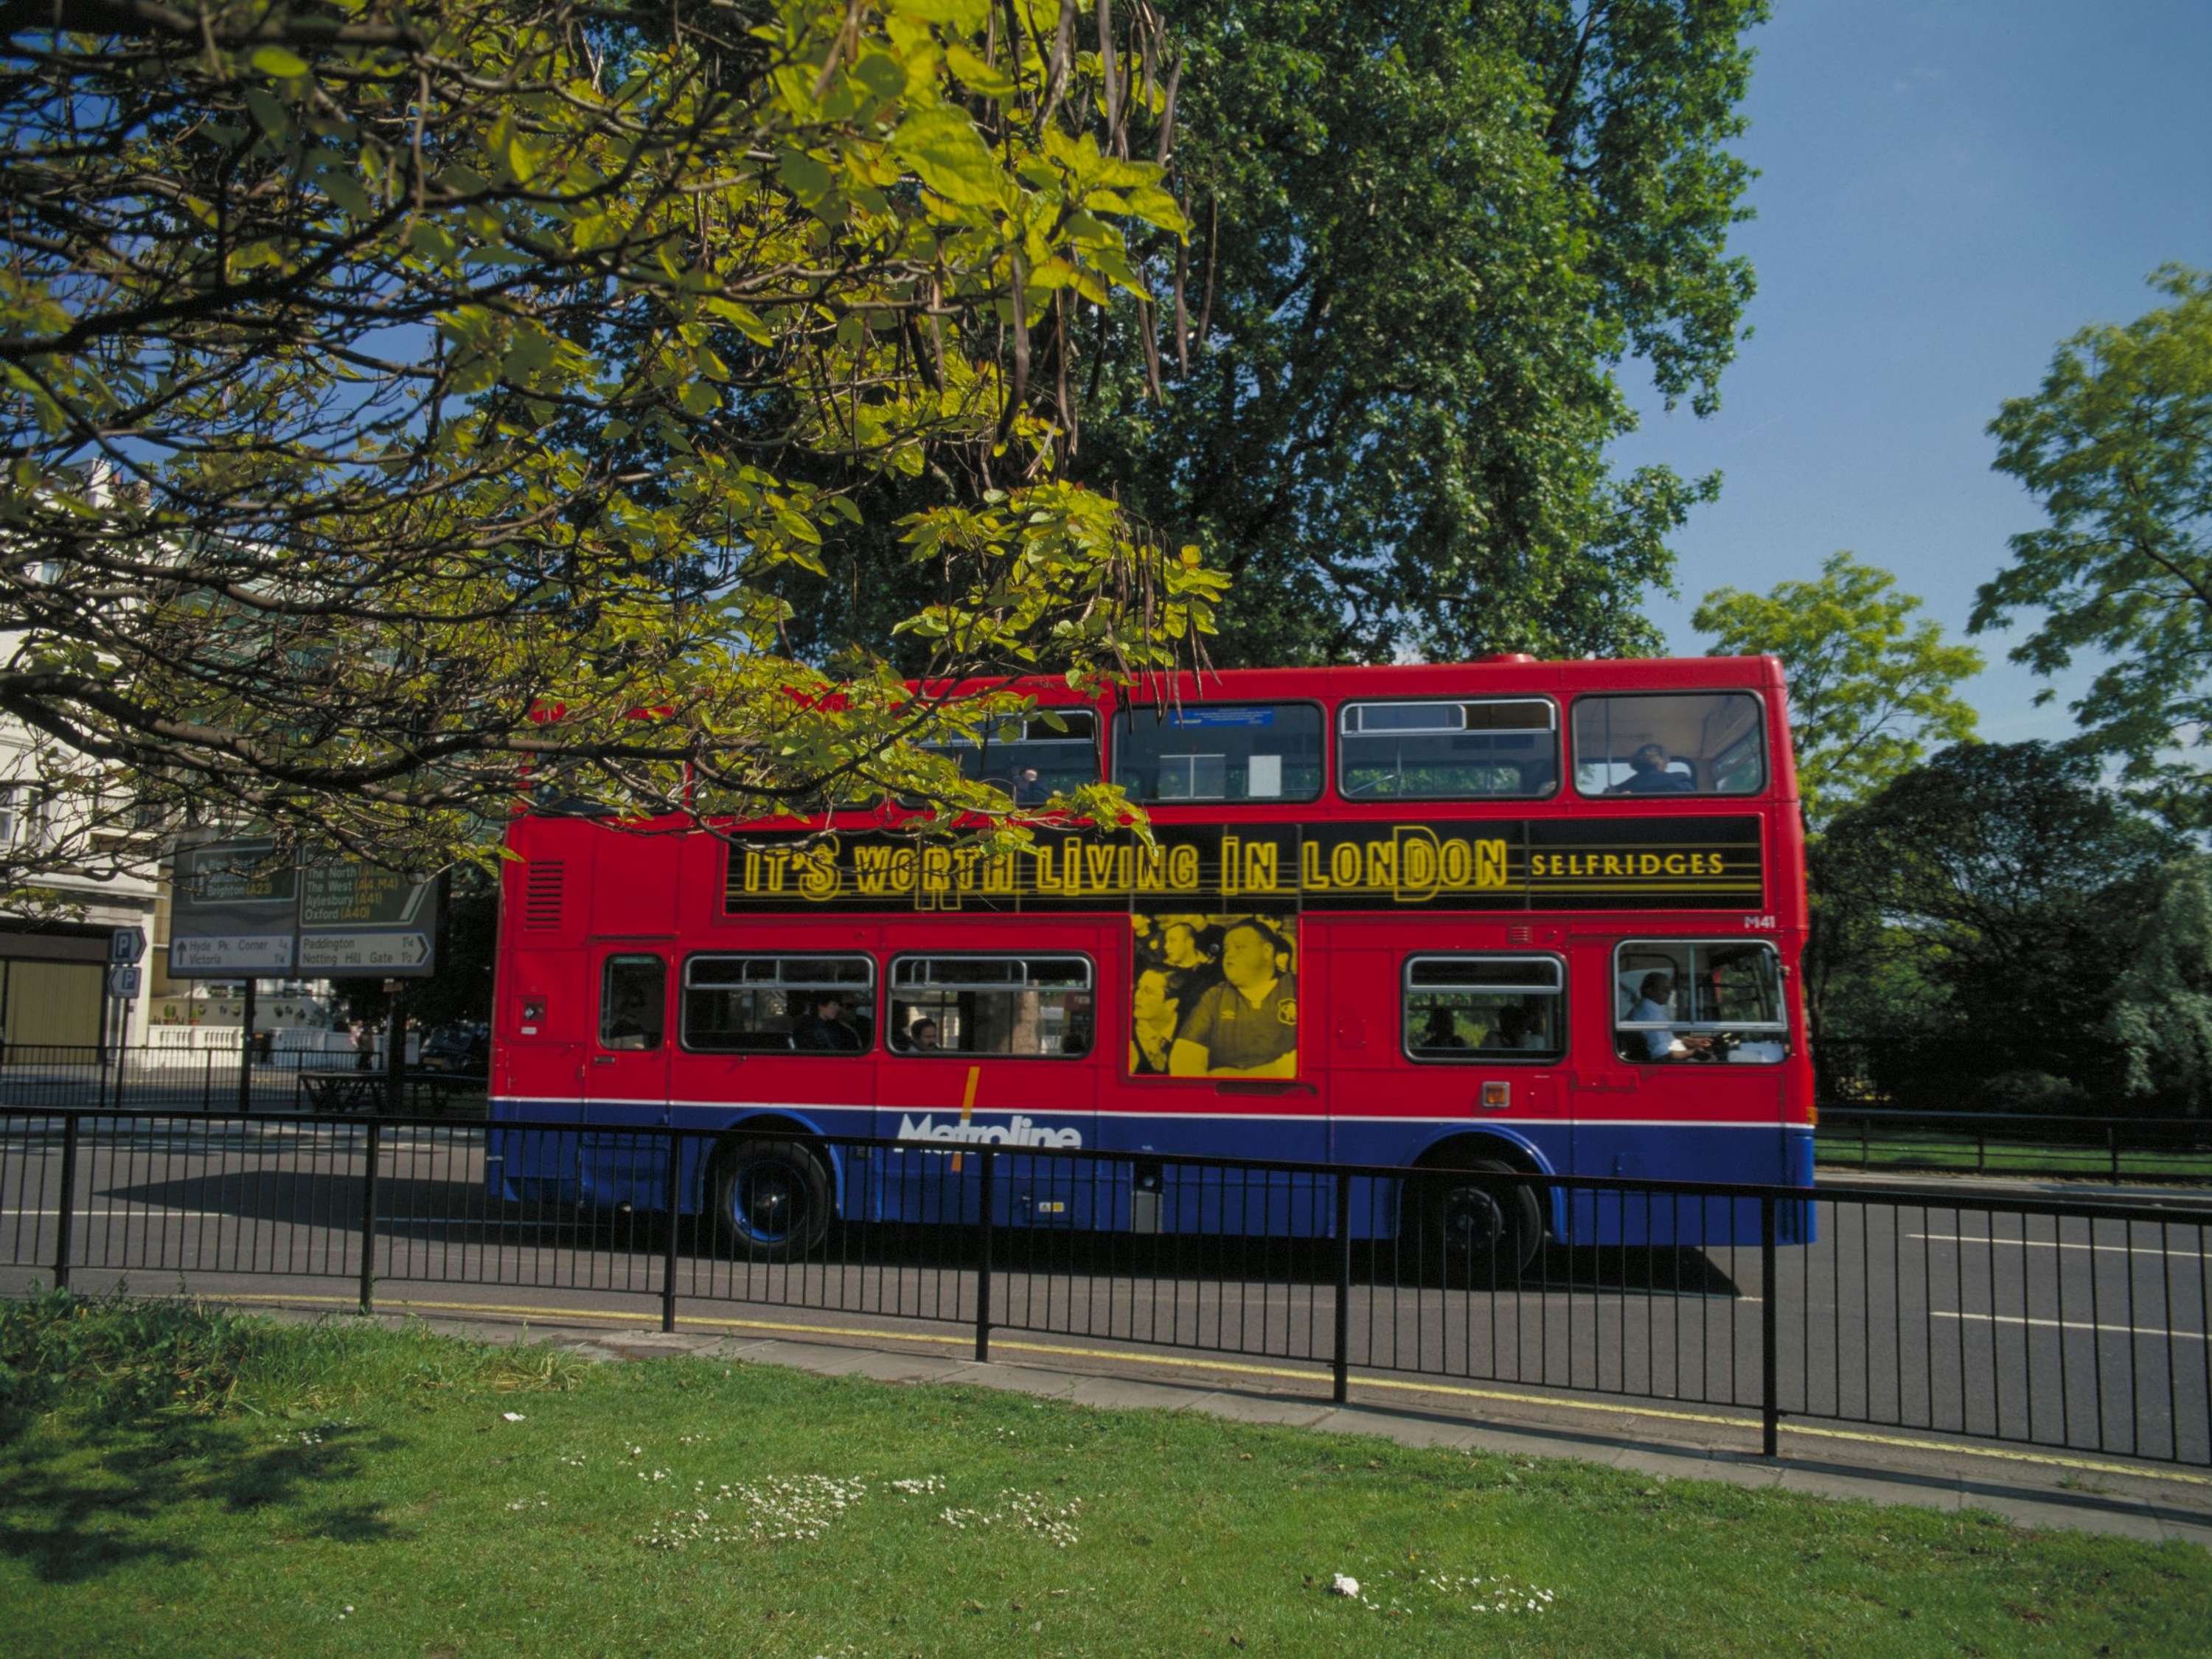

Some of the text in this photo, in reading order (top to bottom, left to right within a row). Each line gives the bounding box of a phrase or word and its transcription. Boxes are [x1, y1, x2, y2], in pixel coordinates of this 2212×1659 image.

[744, 826, 1507, 910] IT'S WORTH LIVING IN LONDON
[1531, 853, 1724, 875] SELFRIDGES
[307, 869, 324, 879] The
[328, 866, 358, 879] North
[306, 880, 324, 892] The
[327, 880, 353, 892] West
[305, 894, 354, 908] Aylesbury
[304, 908, 338, 920] Oxford
[1744, 915, 1775, 928] M41
[118, 936, 129, 956] P
[189, 940, 212, 954] Hyde
[237, 938, 268, 950] Corner
[303, 937, 355, 950] Paddington
[189, 954, 222, 965] Victoria
[303, 953, 338, 965] Notting
[344, 953, 361, 964] Hill
[369, 951, 394, 963] Gate
[125, 972, 133, 989] P
[894, 1113, 1082, 1156] Metroline
